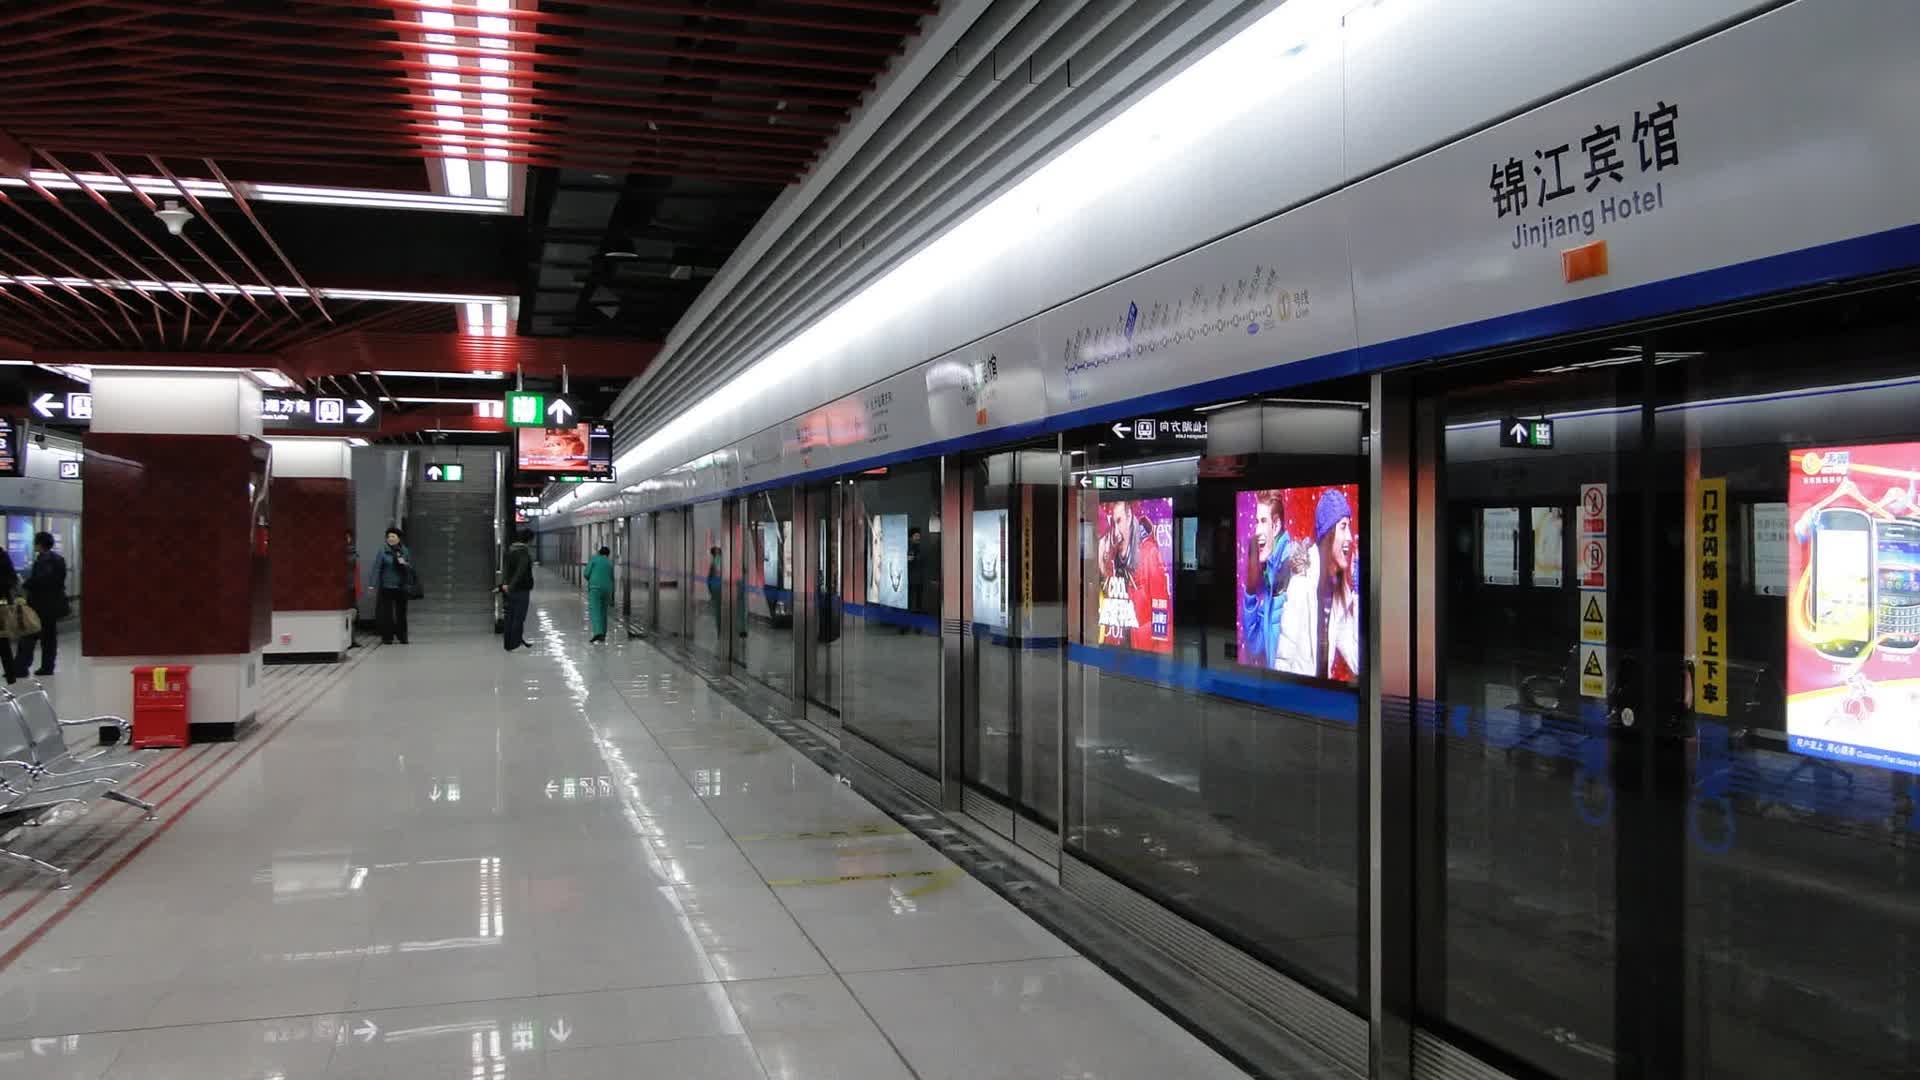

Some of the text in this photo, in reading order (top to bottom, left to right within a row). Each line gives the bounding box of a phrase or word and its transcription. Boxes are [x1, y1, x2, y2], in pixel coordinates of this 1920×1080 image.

[1489, 101, 1680, 218] 锦江宾馆
[1511, 184, 1664, 250] Jinjiang Hotel
